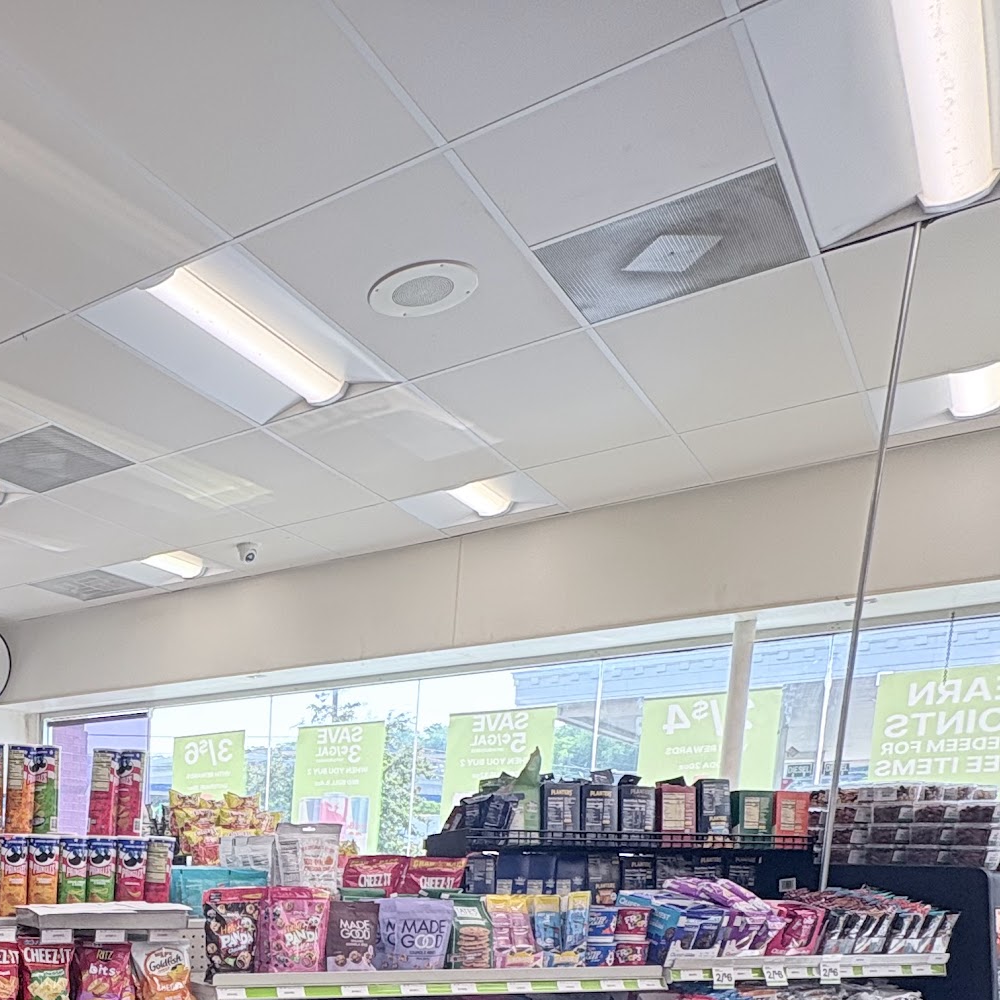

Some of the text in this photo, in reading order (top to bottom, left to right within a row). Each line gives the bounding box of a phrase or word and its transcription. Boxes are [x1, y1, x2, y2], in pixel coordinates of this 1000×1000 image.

[787, 765, 812, 774] DIESEL
[340, 919, 370, 930] MADE
[402, 920, 447, 933] MADE
[221, 932, 254, 948] PANDA
[341, 929, 370, 940] GOOD
[401, 934, 442, 949] GOOD
[24, 946, 73, 965] CHEEZ-IT
[149, 954, 182, 972] Goldfish
[89, 965, 116, 977] bits
